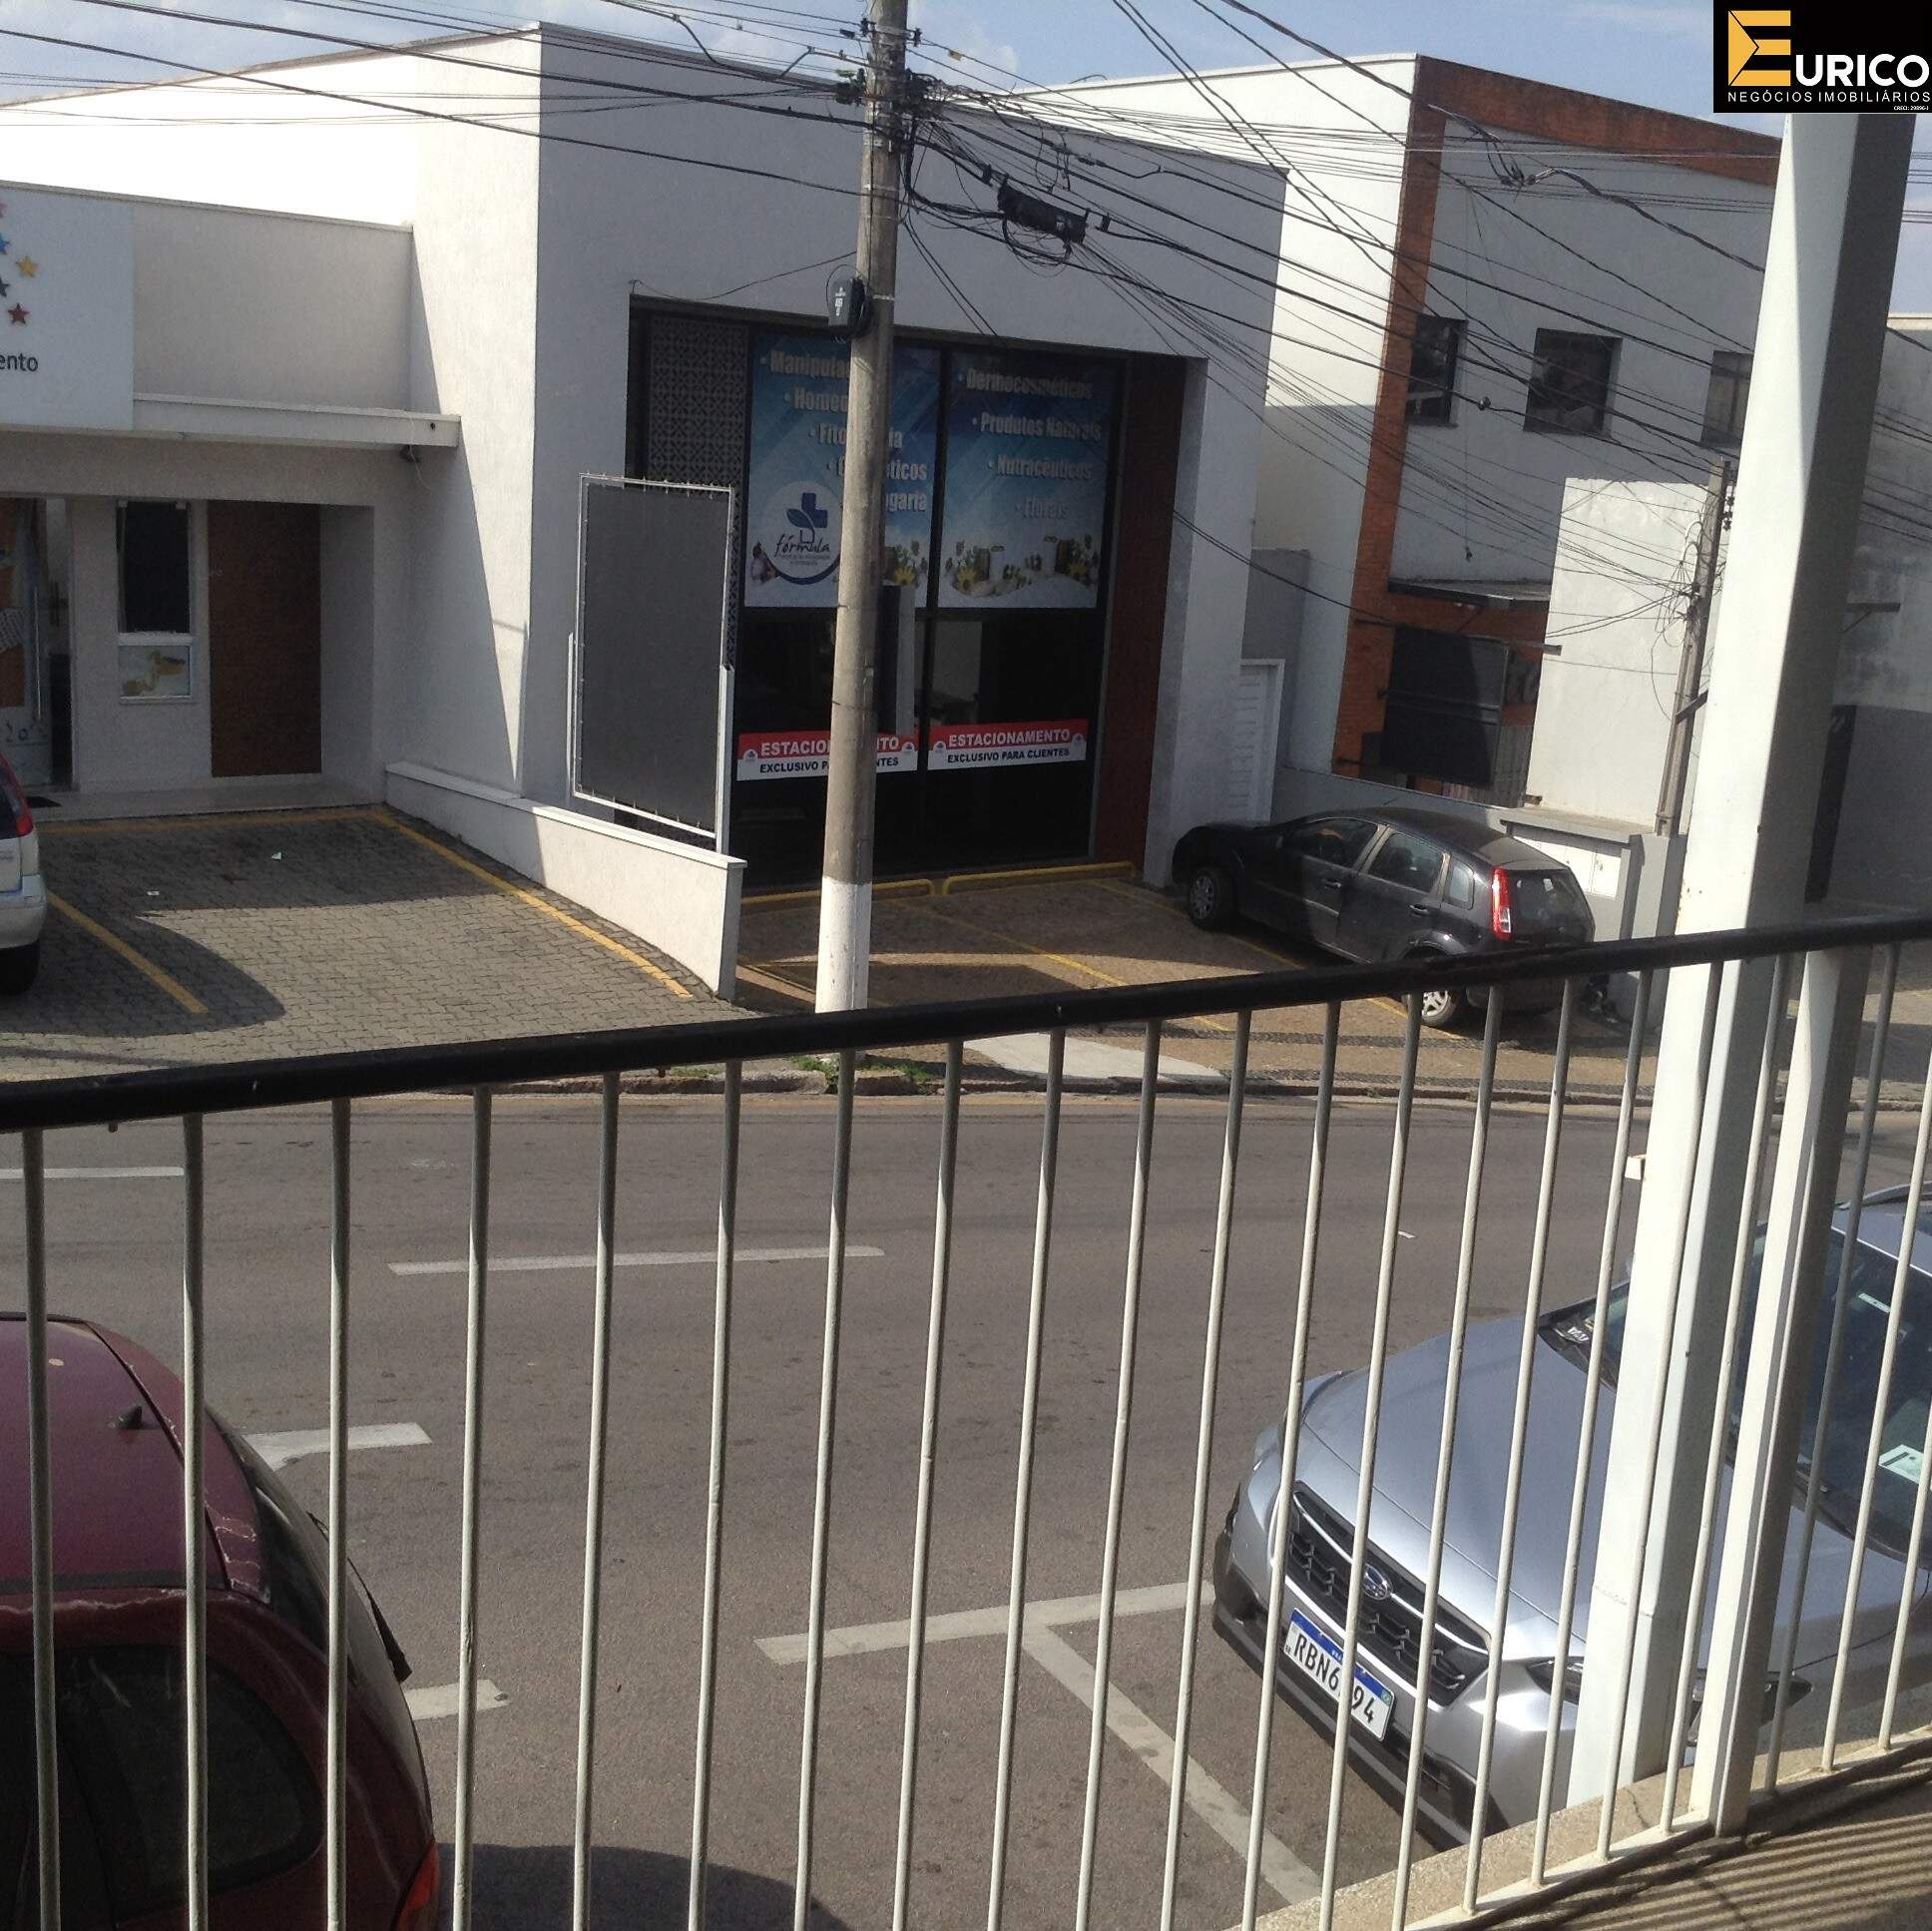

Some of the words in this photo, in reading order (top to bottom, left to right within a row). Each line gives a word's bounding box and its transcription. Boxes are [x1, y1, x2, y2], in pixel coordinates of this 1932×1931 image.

[980, 411, 1043, 437] Produtos
[760, 736, 899, 757] ESTACIOTO
[948, 728, 1071, 747] ESTACIONAMENTO
[948, 753, 999, 763] EXCLUSIVO
[1001, 750, 1026, 760] PARA
[1028, 747, 1071, 758] CLIENTES
[759, 759, 819, 774] EXCLUSIVO
[1293, 1634, 1375, 1724] RBN694
